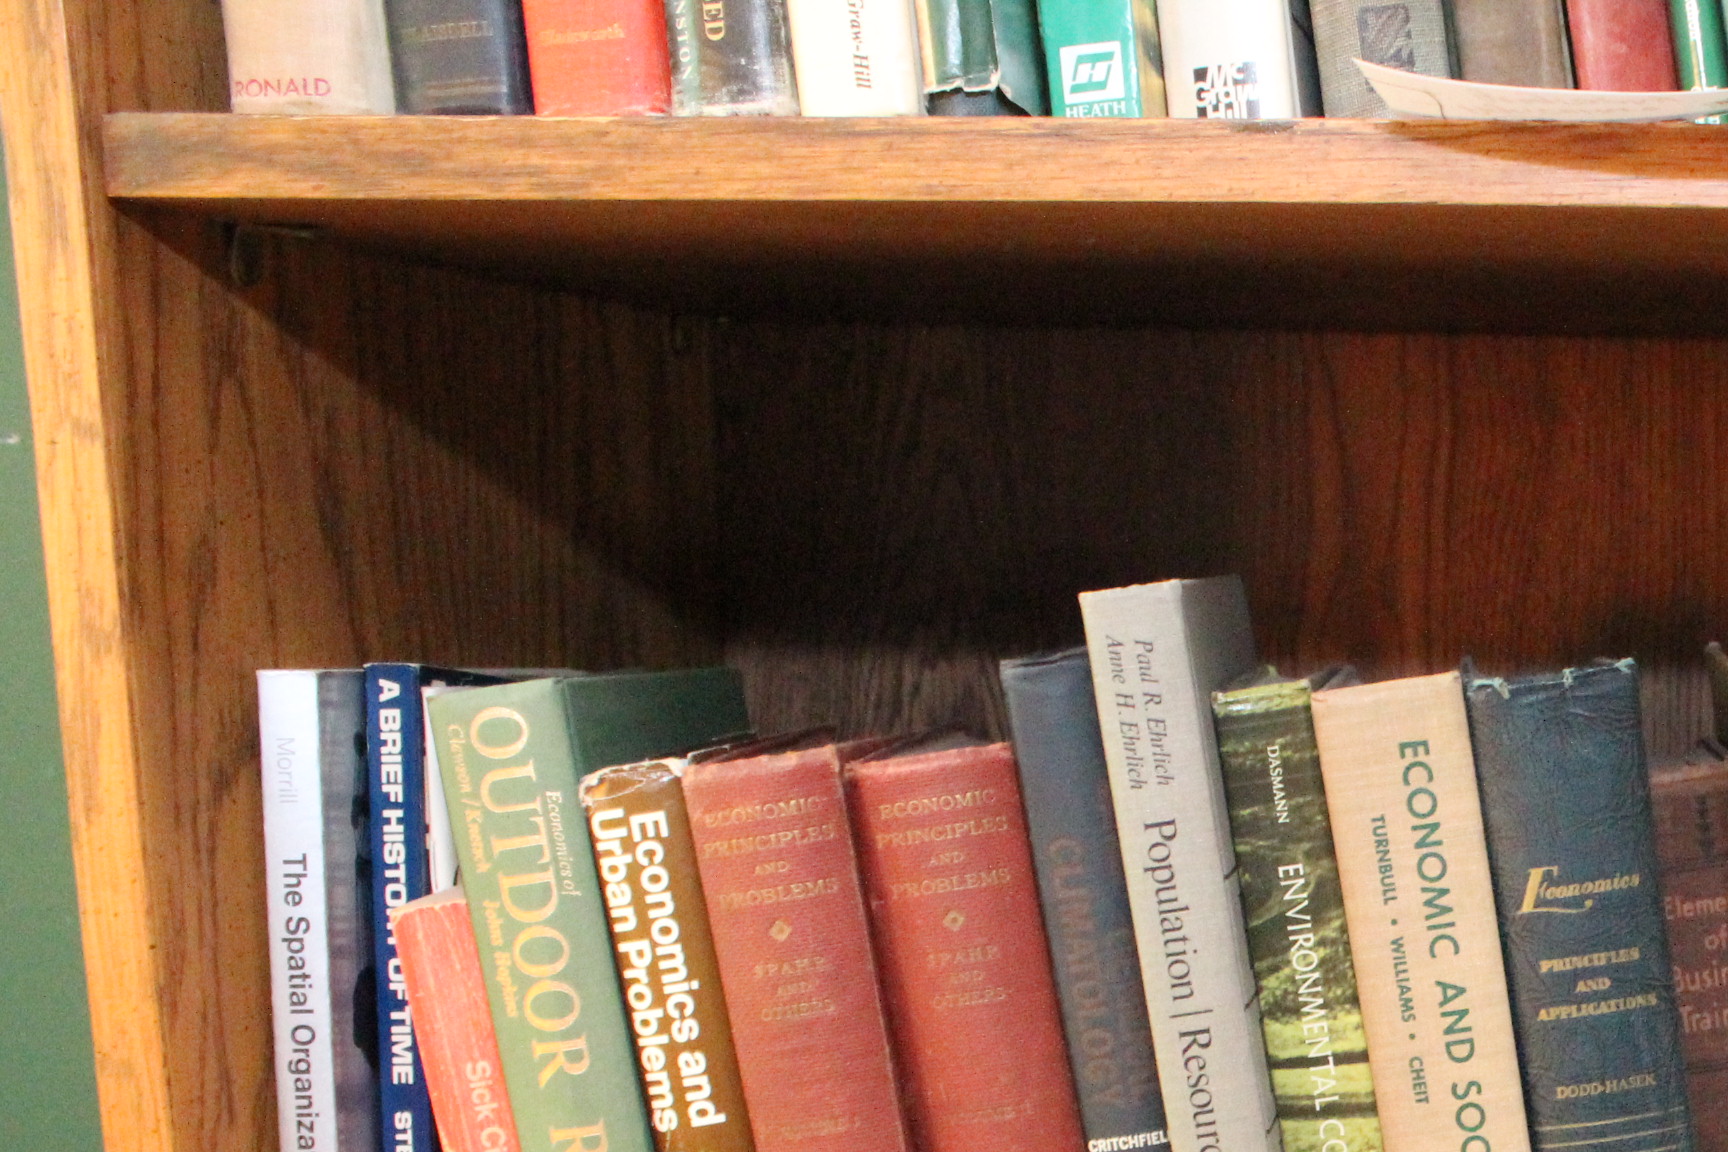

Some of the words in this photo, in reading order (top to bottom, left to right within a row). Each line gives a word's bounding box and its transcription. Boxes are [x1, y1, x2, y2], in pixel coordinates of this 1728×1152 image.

[235, 78, 331, 97] RONALD
[1065, 101, 1127, 118] HEATH
[1104, 635, 1127, 684] Anne
[1134, 638, 1161, 683] Paul
[379, 678, 400, 702] A
[1115, 693, 1135, 715] H.
[1141, 690, 1161, 713] R.
[274, 737, 299, 804] Morrill
[379, 708, 403, 805] BRIEF
[1119, 721, 1148, 790] Ehrlich
[1147, 719, 1175, 786] Ehrlich
[880, 789, 996, 820] ECONOMIC
[1267, 745, 1290, 824] DASMANN
[546, 791, 578, 882] Economics
[703, 824, 835, 859] PRINCIPLES
[876, 815, 1009, 850] PRINCIPLES
[282, 853, 308, 906] The
[753, 860, 790, 876] AND
[890, 868, 1011, 899] PROBLEMS
[928, 851, 965, 867] AND
[470, 706, 590, 1089] OUTDOOR
[560, 881, 582, 899] of
[717, 877, 841, 909] PROBLEMS
[1143, 819, 1198, 1002] Population
[1398, 740, 1460, 959] ECONOMIC
[1435, 980, 1476, 1064] AND
[1516, 865, 1641, 916] Economics
[1370, 814, 1398, 907] TURNBULL
[1389, 936, 1416, 1024] WILLIAMS
[1408, 1056, 1430, 1105] CHEIT
[1539, 947, 1641, 973] PRINCIPLES
[1706, 925, 1728, 952] of
[281, 916, 313, 1014] Spatial
[591, 808, 637, 933] Urban
[618, 939, 679, 1134] Problems
[629, 810, 700, 1041] Economics
[678, 1050, 727, 1128] and
[1278, 863, 1339, 1111] ENVIRONMENTAL
[1575, 977, 1611, 993] AND
[1537, 993, 1657, 1022] APPLICATIONS
[389, 1004, 414, 1086] TIME
[466, 1060, 496, 1122] Sick
